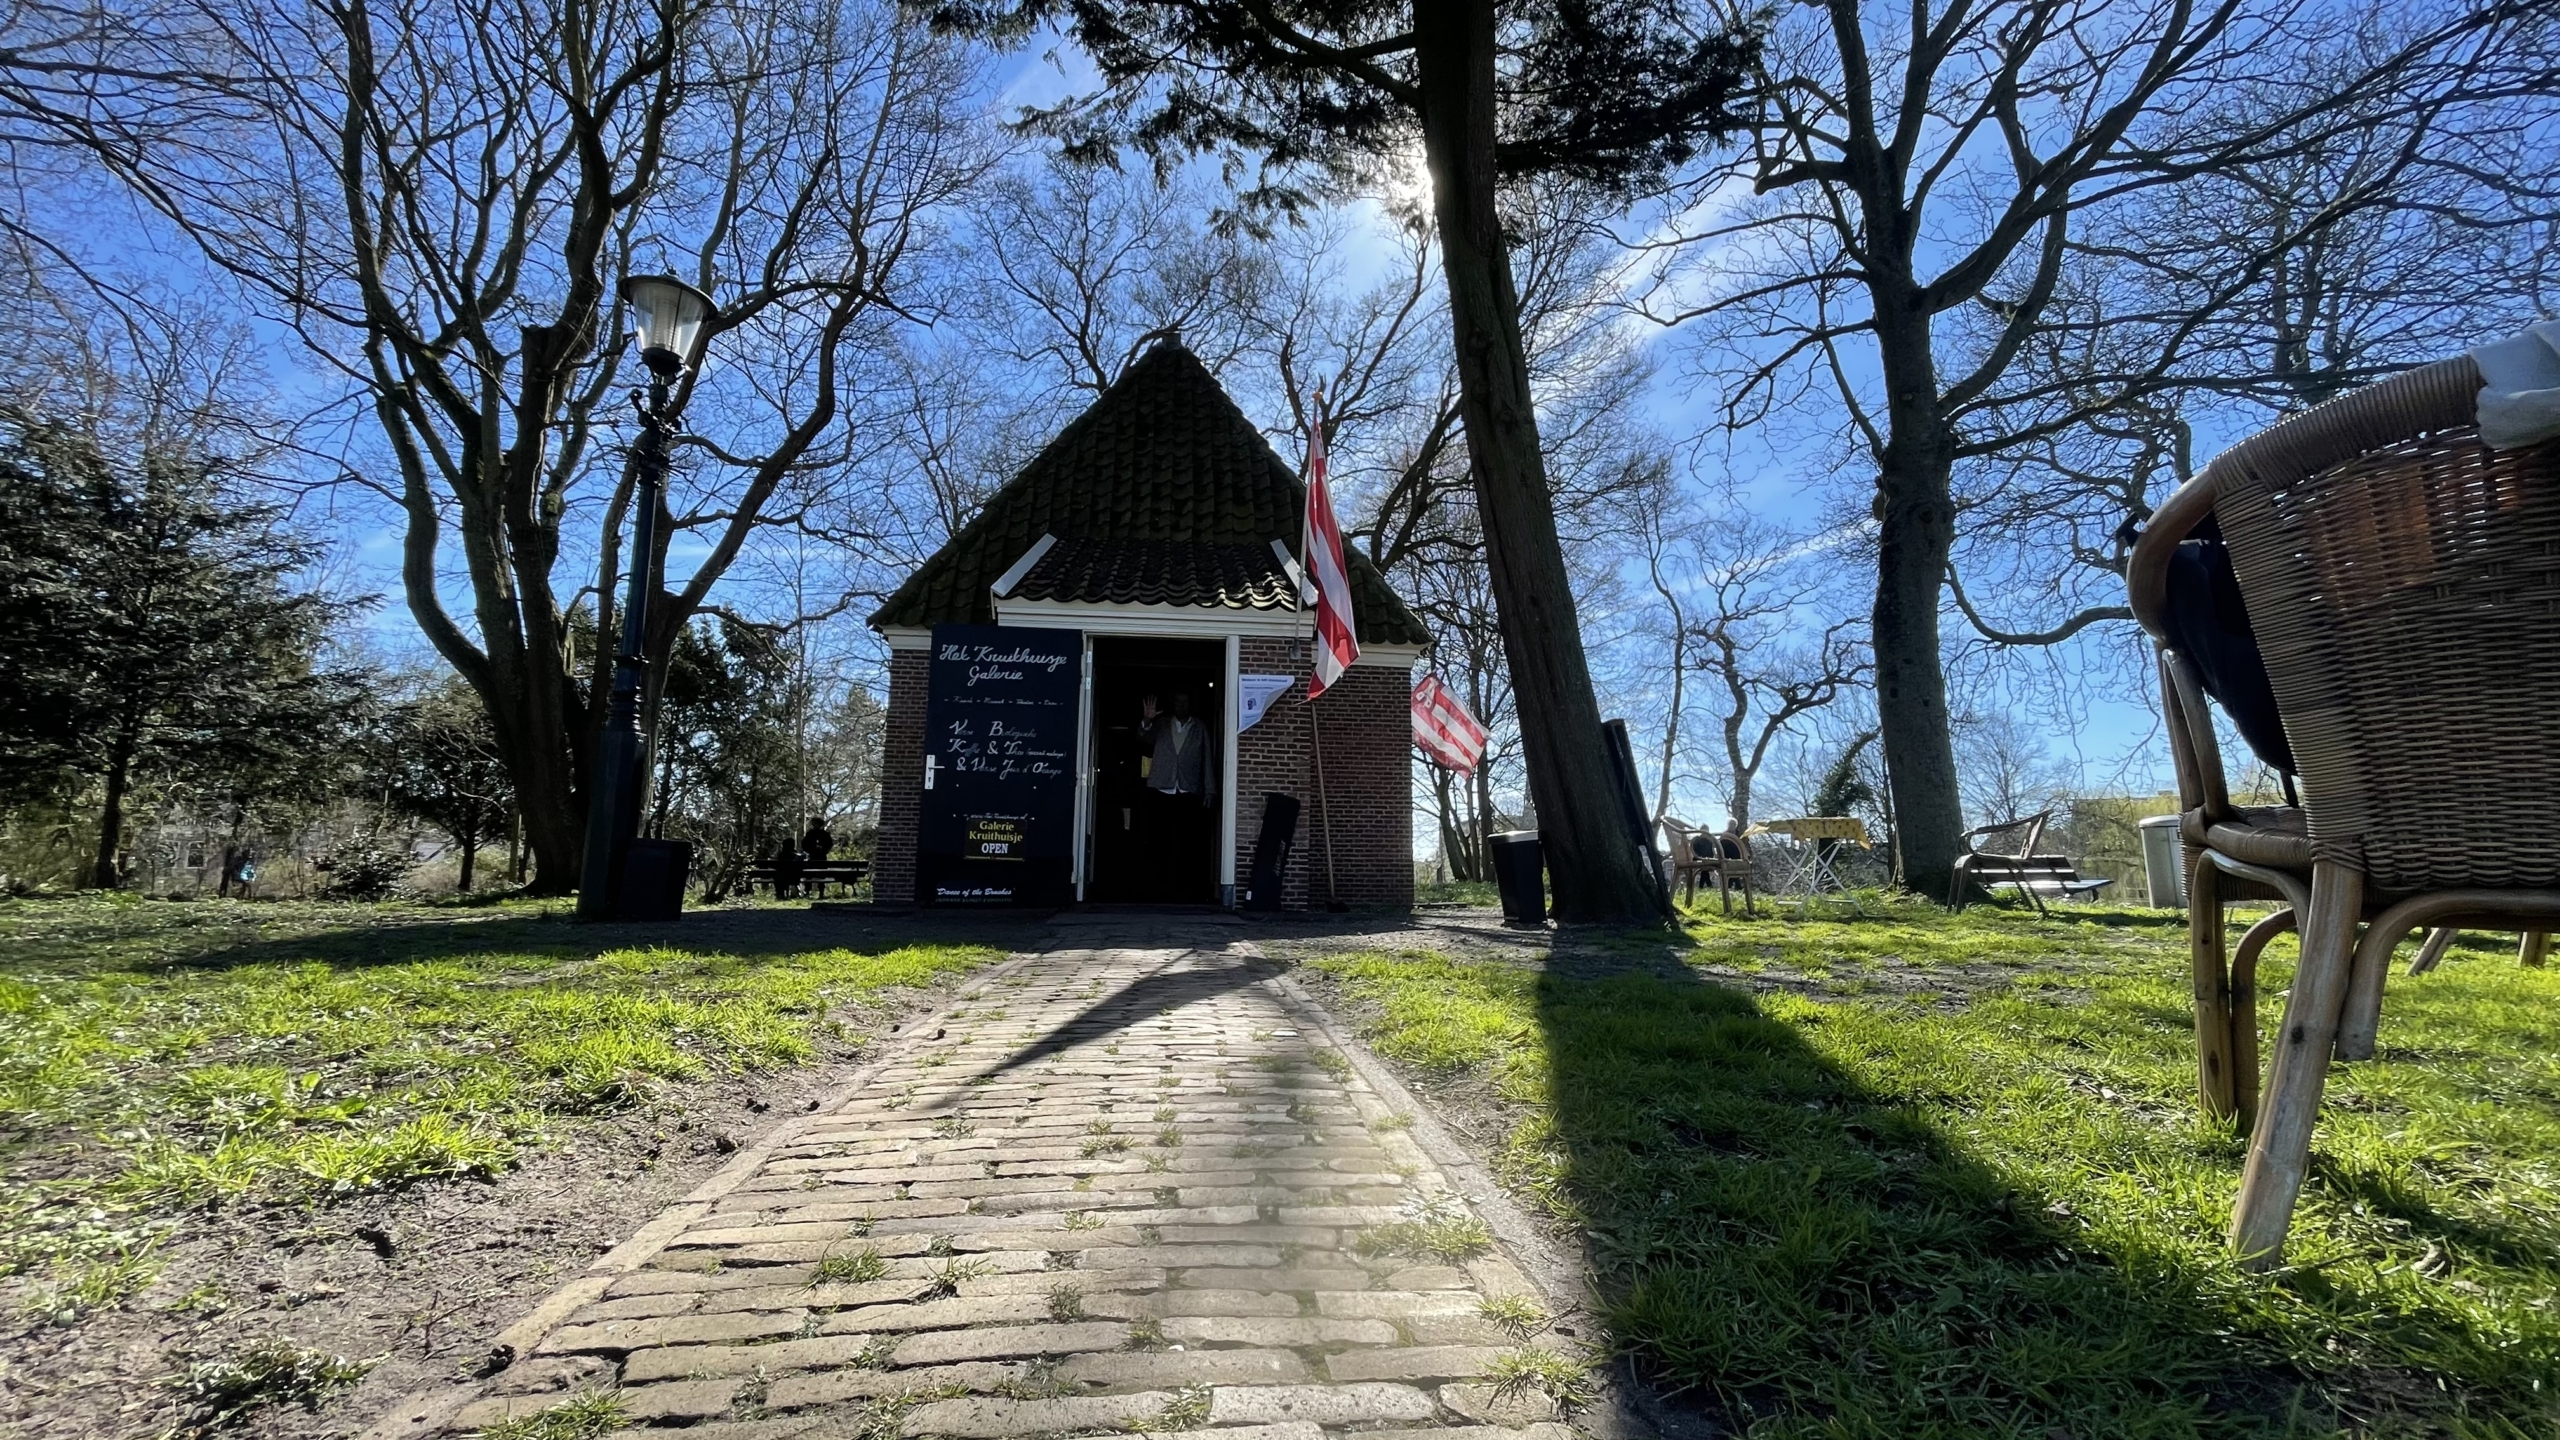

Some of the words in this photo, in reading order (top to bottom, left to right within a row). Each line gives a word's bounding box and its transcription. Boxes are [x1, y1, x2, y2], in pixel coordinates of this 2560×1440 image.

[967, 665, 1023, 687] Galerie
[987, 740, 999, 755] &
[956, 756, 967, 771] &
[979, 820, 1015, 832] Galerie
[969, 830, 1024, 844] Kruithuisje
[981, 842, 1009, 854] OPEN
